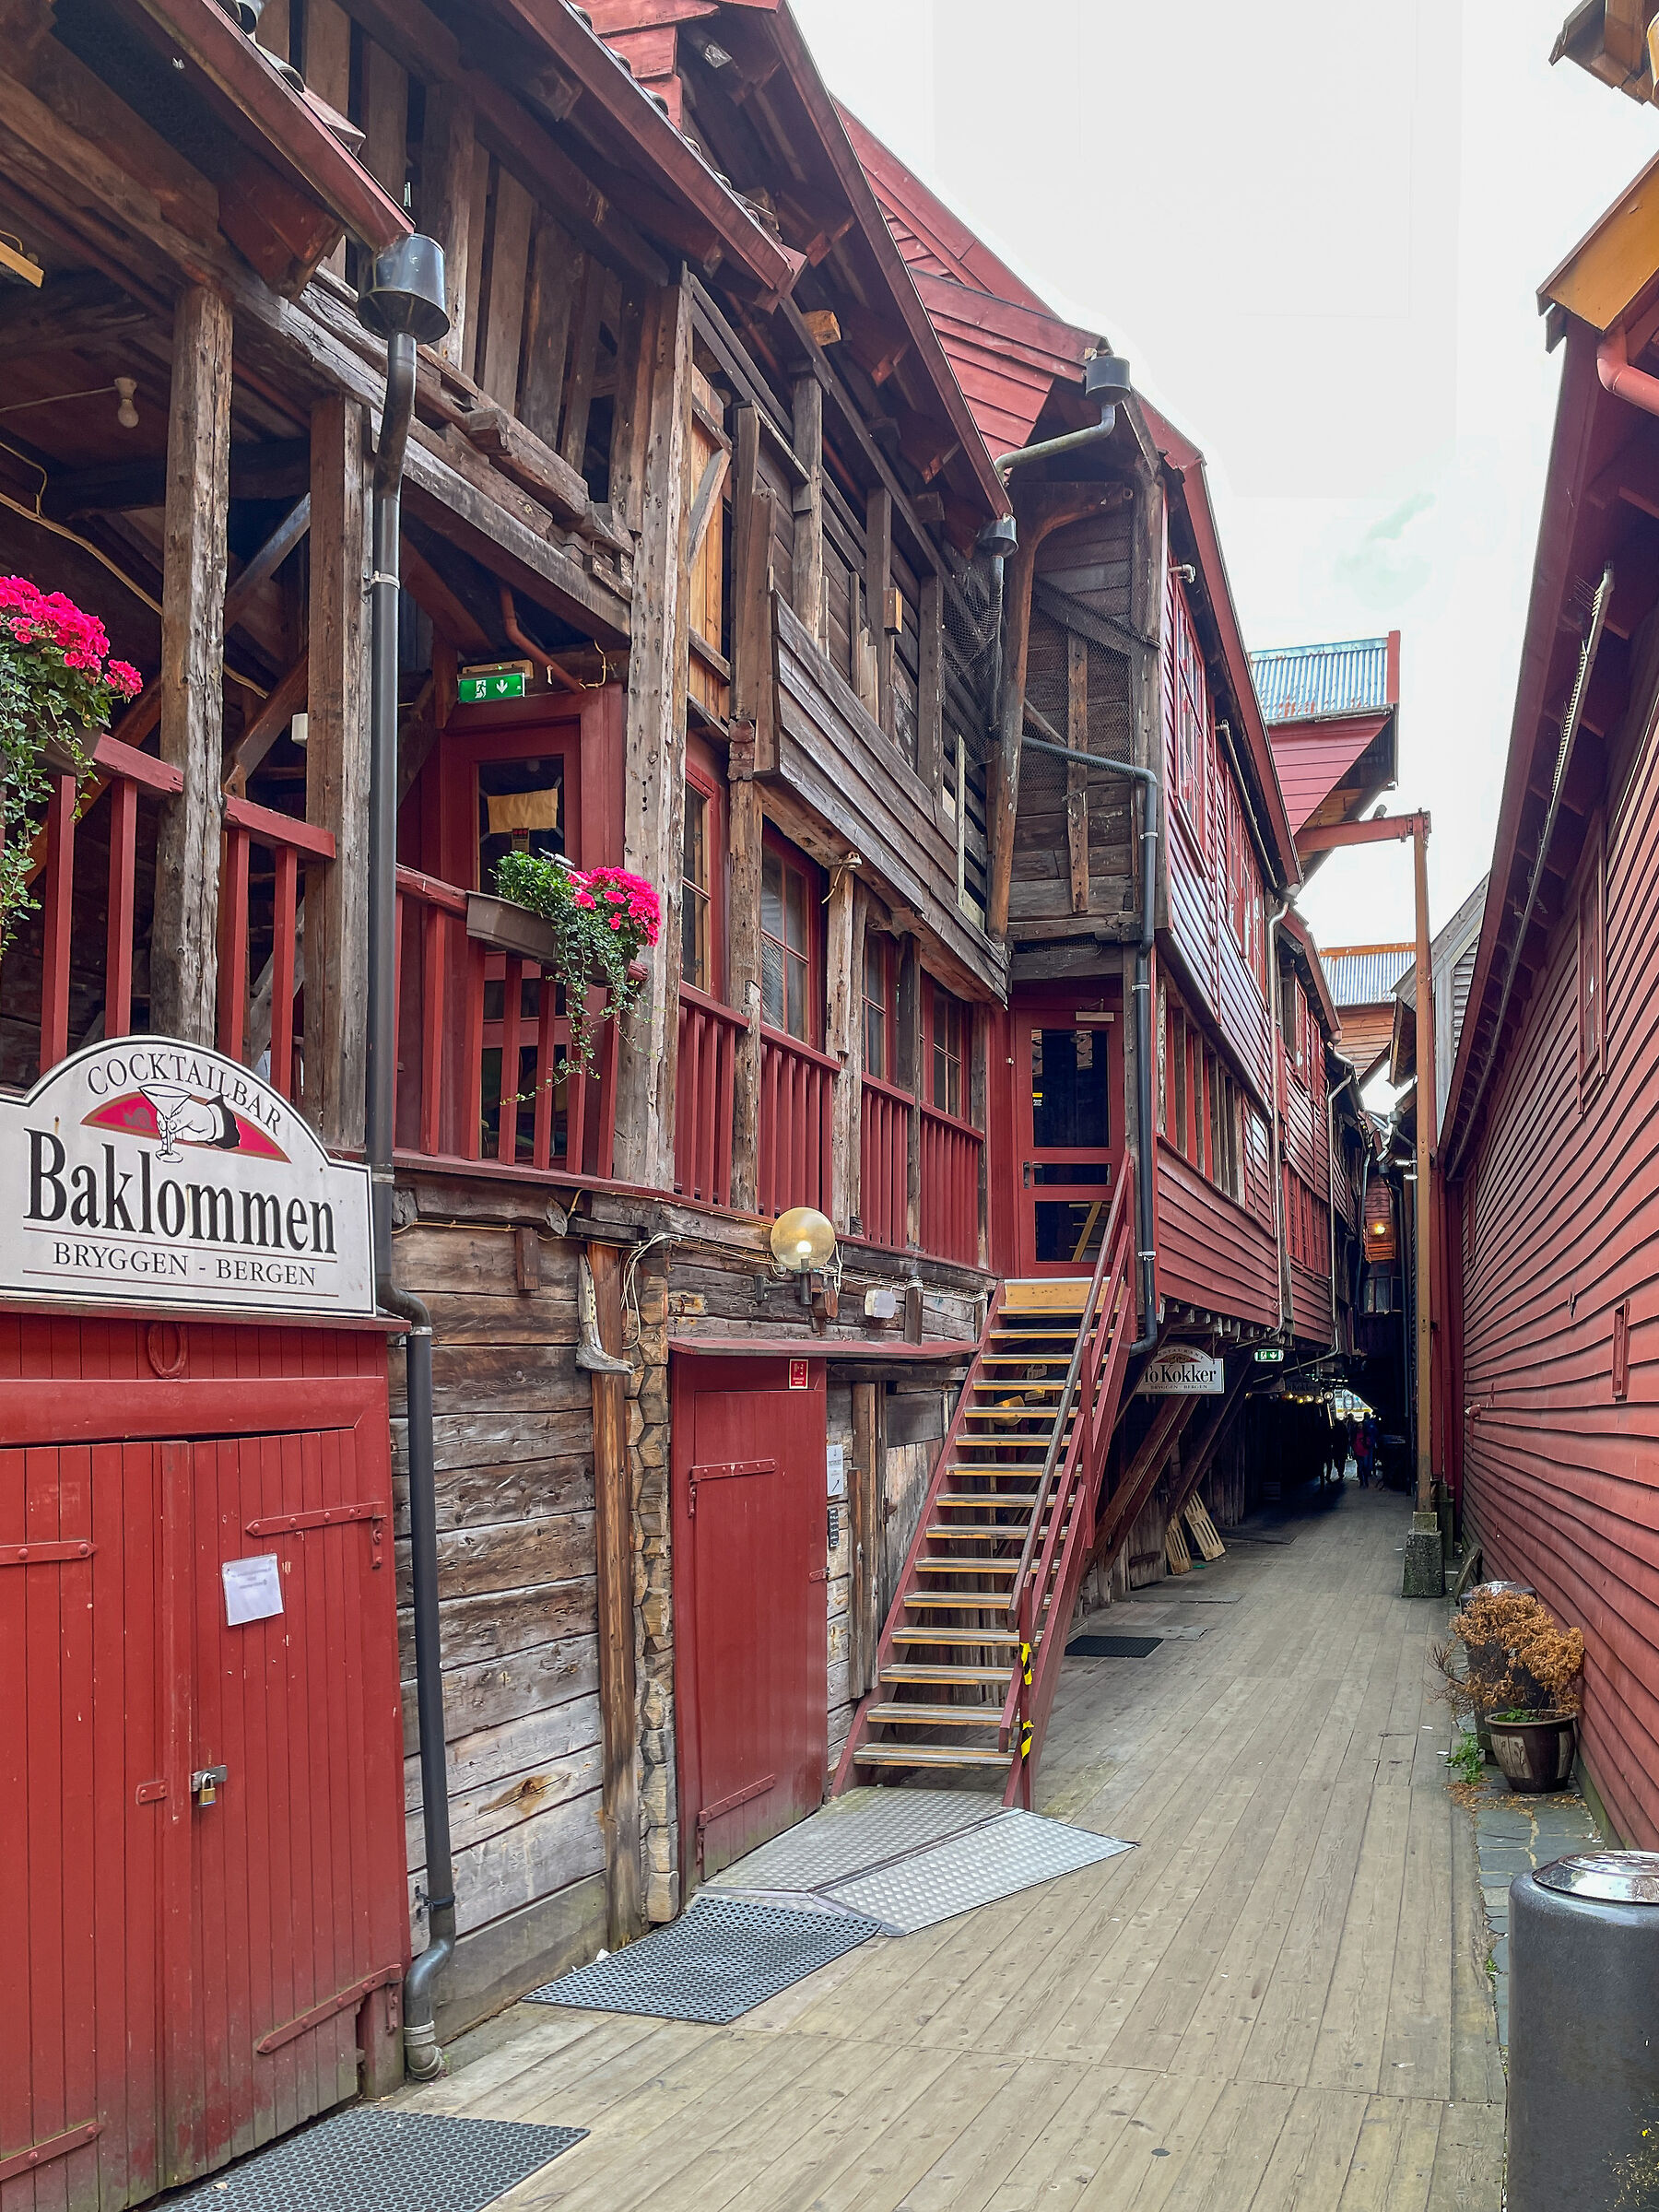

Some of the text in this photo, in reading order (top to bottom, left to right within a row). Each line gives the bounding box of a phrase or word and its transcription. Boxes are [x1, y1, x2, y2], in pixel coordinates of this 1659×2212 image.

[88, 1053, 281, 1135] COCKTAILBAR
[23, 1127, 337, 1254] Baklommen
[53, 1241, 189, 1277] BRYGGEN
[216, 1258, 316, 1287] BERGEN
[1160, 1364, 1217, 1382] Kokker
